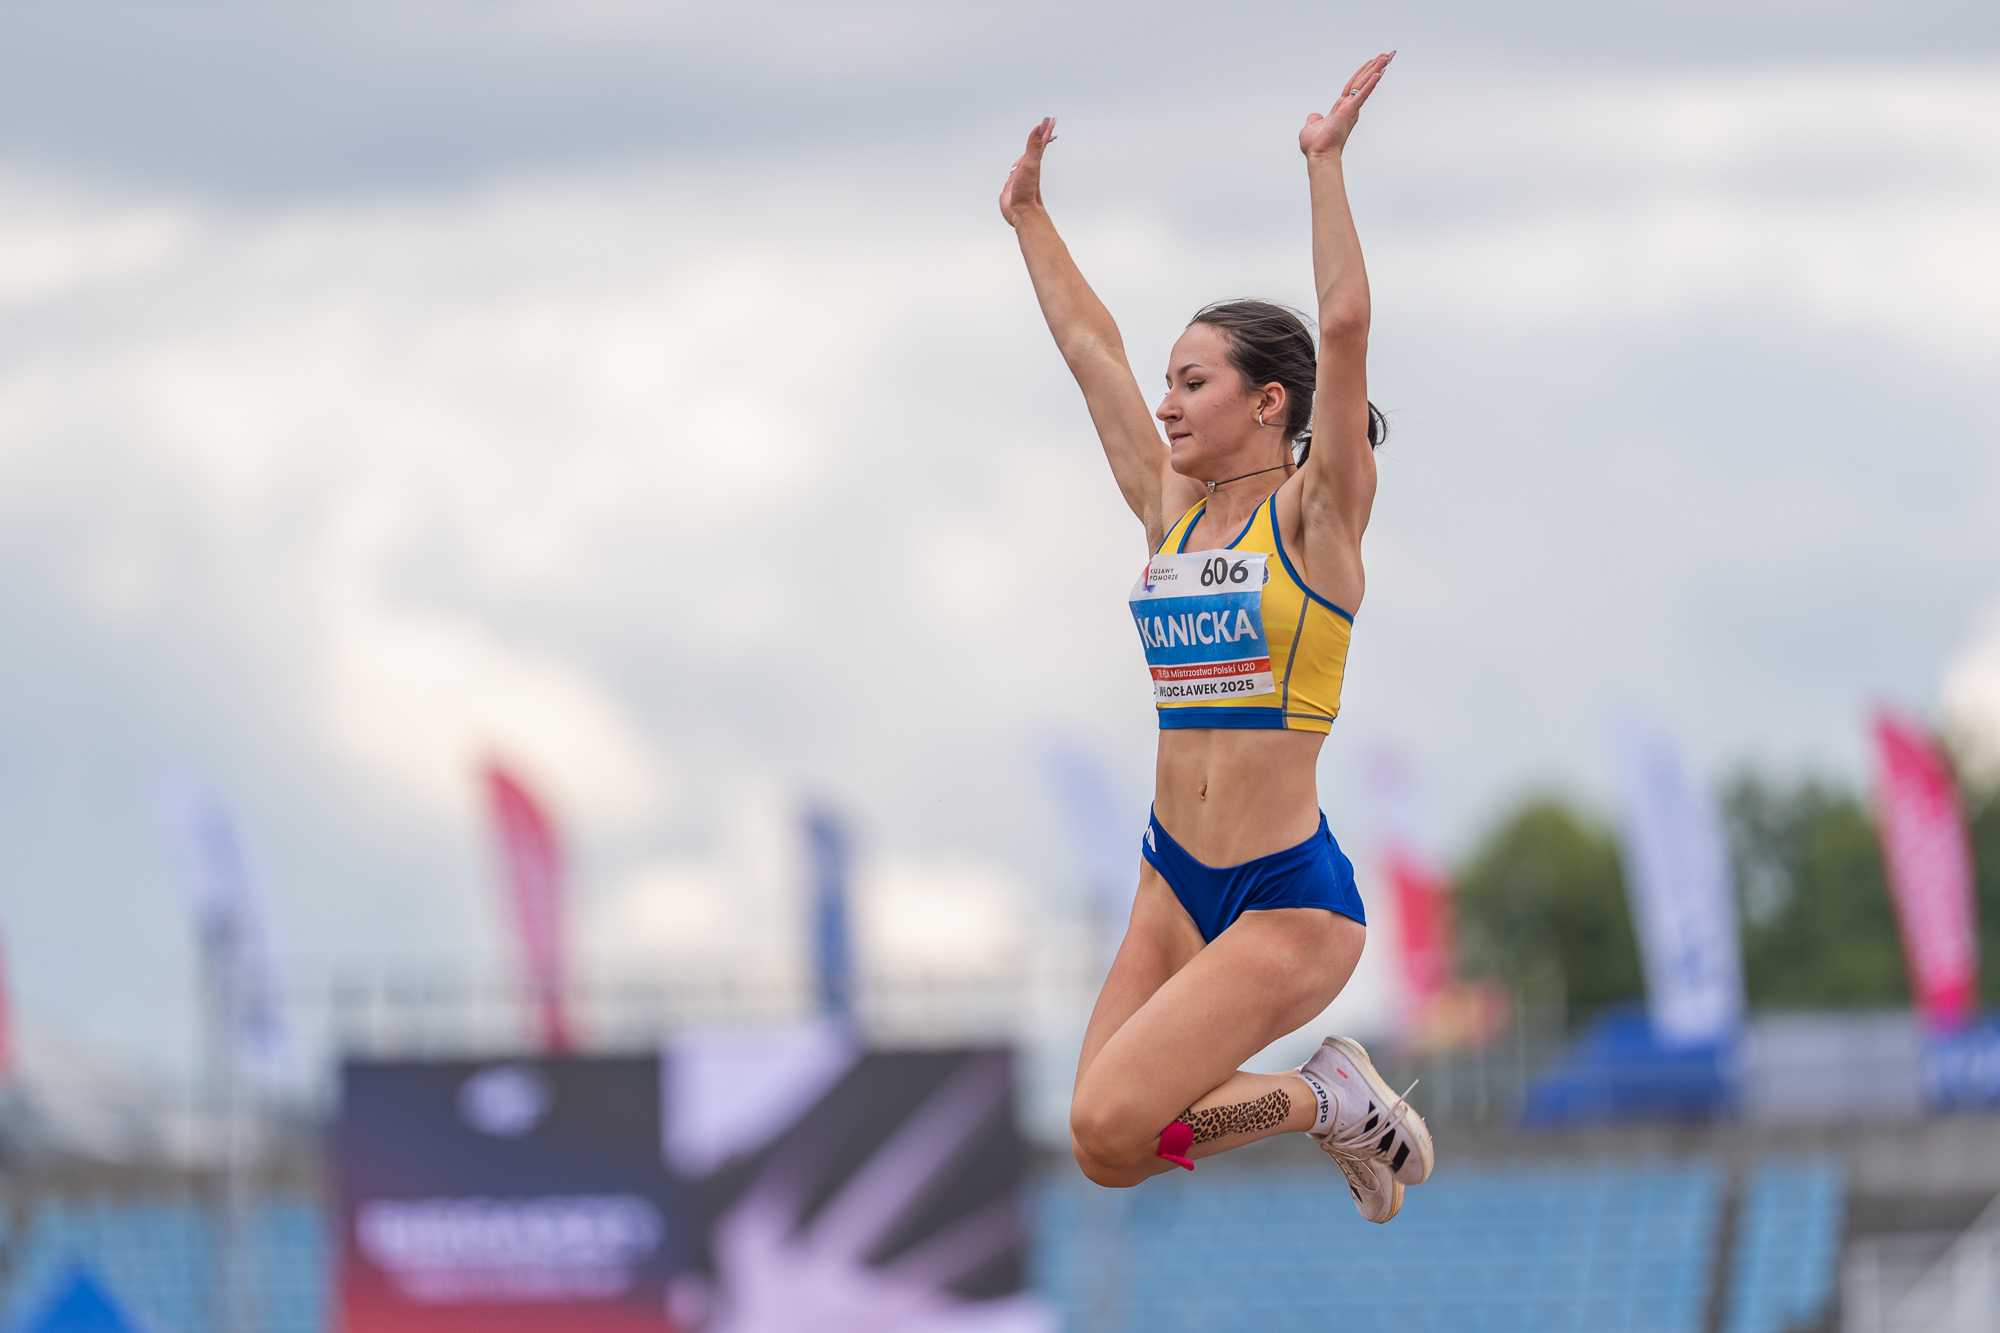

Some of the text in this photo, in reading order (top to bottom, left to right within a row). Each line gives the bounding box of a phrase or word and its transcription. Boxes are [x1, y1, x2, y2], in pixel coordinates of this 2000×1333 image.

[1200, 557, 1249, 587] 606
[1137, 609, 1259, 649] KANICKA
[1170, 667, 1212, 678] Mistrzostwa
[1213, 664, 1236, 675] Polski
[1237, 662, 1256, 672] U20
[1220, 679, 1255, 693] 2025
